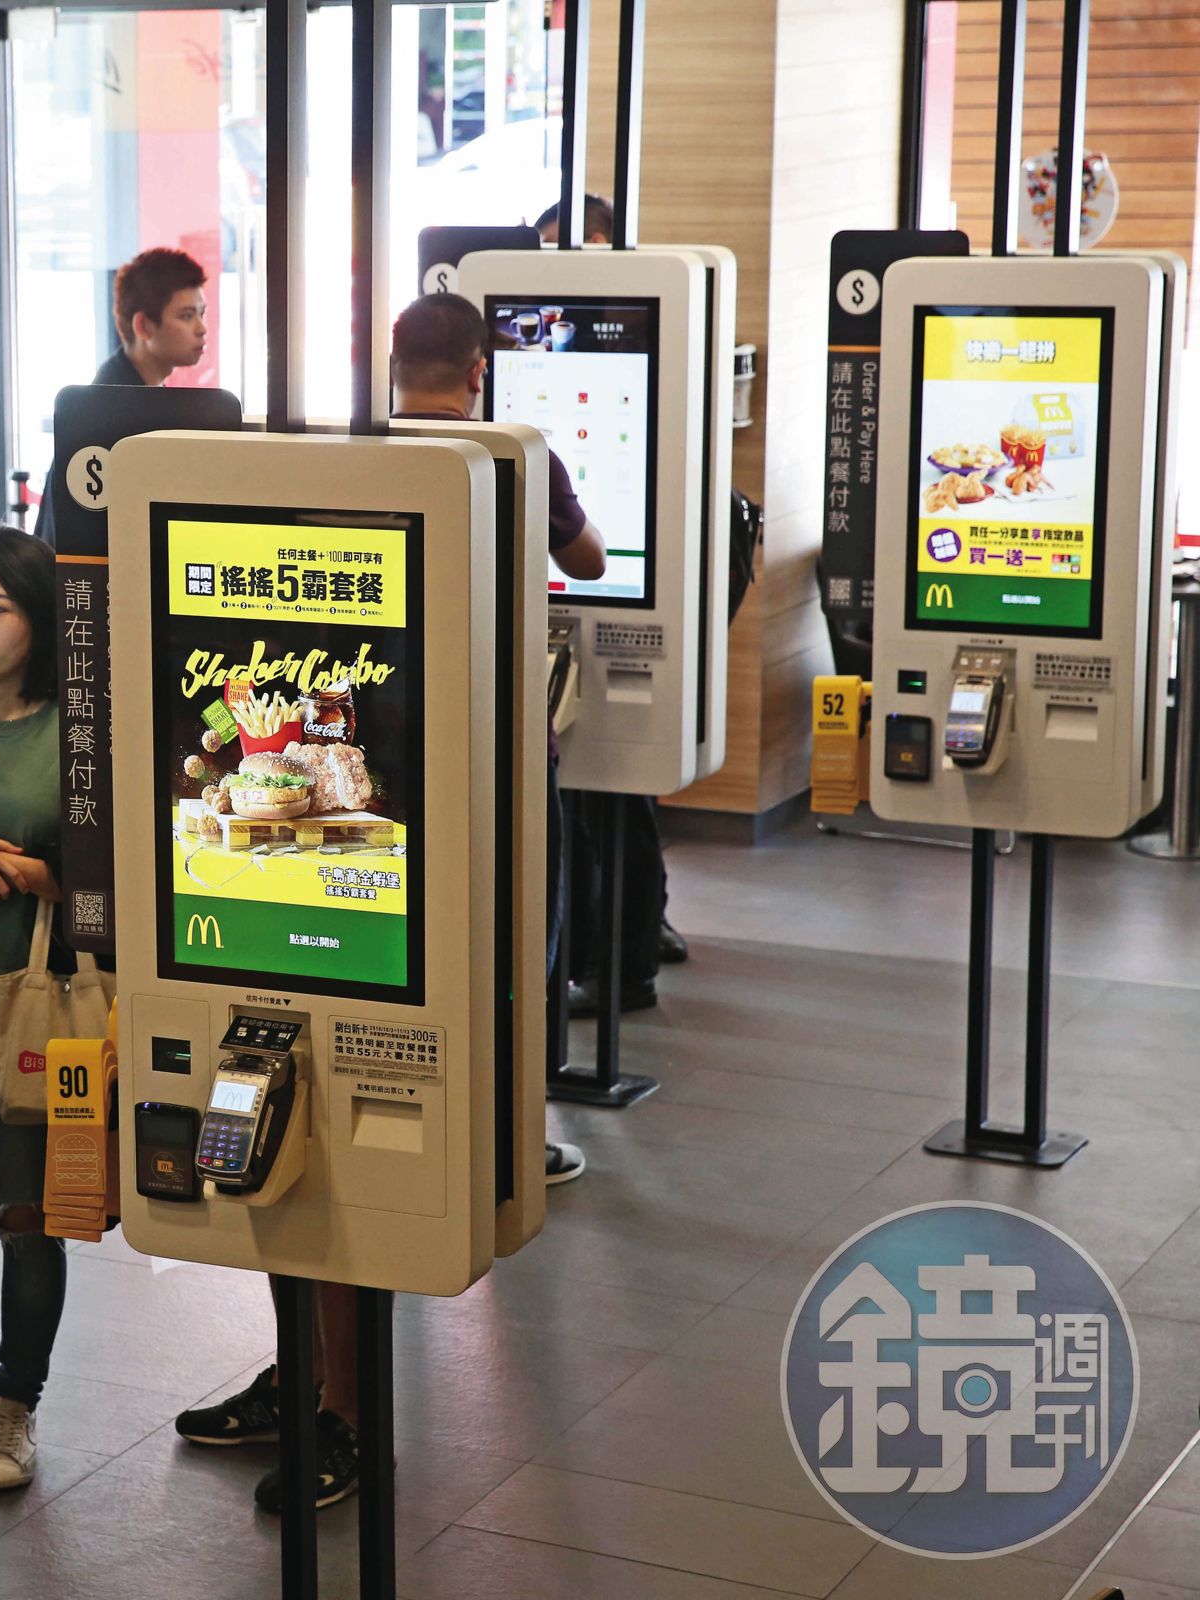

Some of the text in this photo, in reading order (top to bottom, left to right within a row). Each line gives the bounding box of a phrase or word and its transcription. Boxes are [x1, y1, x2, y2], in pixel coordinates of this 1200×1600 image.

[857, 361, 877, 484] Order & Pay Here
[828, 362, 854, 533] 請在此點餐付款
[969, 547, 1042, 566] 買一送一
[188, 565, 212, 580] 期間
[188, 579, 213, 594] 限定
[64, 578, 98, 827] 請在此點餐付款
[823, 693, 844, 716] 52
[318, 867, 400, 889] 千島黃金蝦堡
[289, 933, 340, 949] 點選以開始
[335, 1021, 369, 1036] 刷台新卡
[410, 1029, 438, 1043] 300元
[59, 1065, 88, 1098] 90
